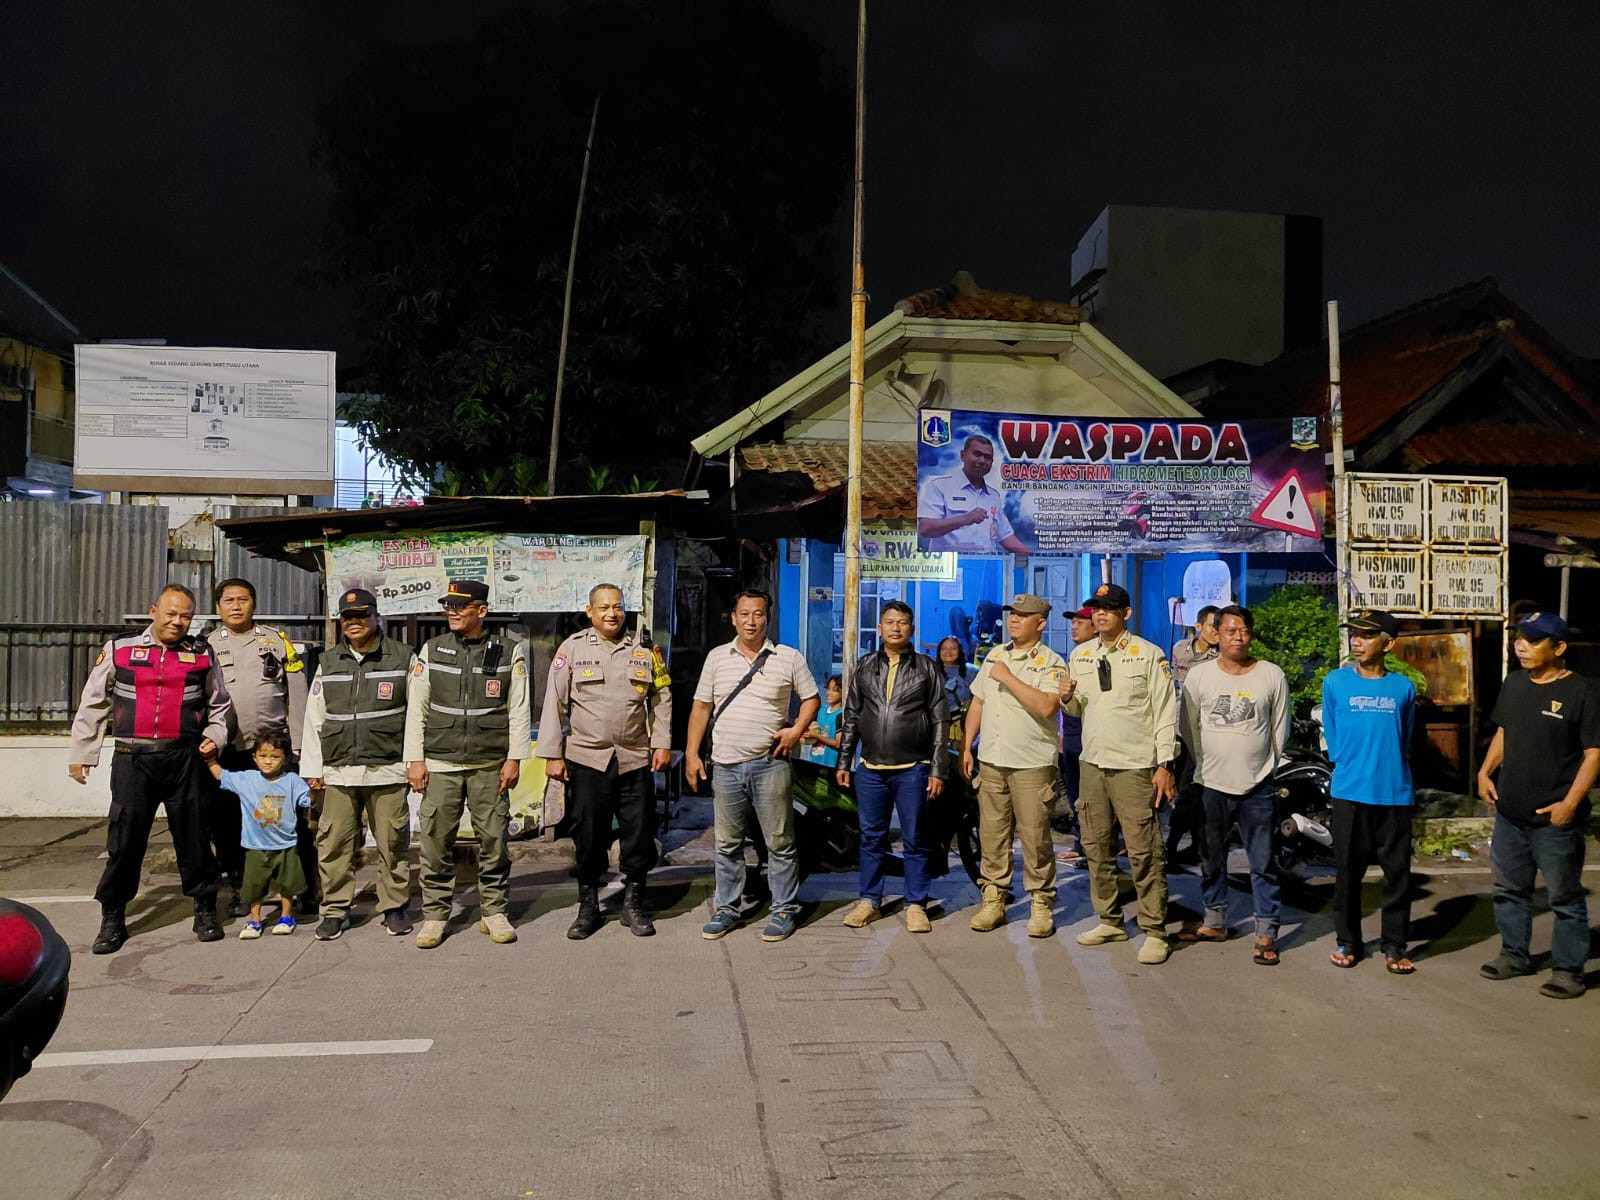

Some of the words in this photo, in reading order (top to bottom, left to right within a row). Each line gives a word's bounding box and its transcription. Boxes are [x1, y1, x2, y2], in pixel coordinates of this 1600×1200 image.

[1000, 420, 1251, 463] WASPADA
[1001, 463, 1048, 481] CUACA
[1051, 464, 1112, 481] EKSTRIM
[1115, 465, 1252, 482] HIDROMETEOROLOGI
[1001, 482, 1030, 490] BANJIR
[1361, 487, 1414, 504] EKRETARIAT
[1390, 505, 1404, 520] 05
[1472, 508, 1486, 523] 05
[1372, 523, 1390, 537] TUGU
[1394, 524, 1417, 537] UTARA
[1452, 525, 1470, 539] TUGU
[1473, 525, 1496, 540] UTARA
[383, 540, 400, 552] ES
[404, 538, 431, 551] TEH
[884, 541, 917, 559] RW.
[378, 552, 437, 571] JUMBO
[902, 565, 920, 573] TUGU
[921, 565, 944, 573] UTARA
[1358, 555, 1416, 574] POSYANDU
[1369, 574, 1389, 589] RW.
[1391, 574, 1405, 589] 05
[1470, 578, 1484, 593] 05
[382, 588, 399, 599] Rp
[400, 581, 432, 595] 3000
[1370, 592, 1388, 606] TUGU
[1452, 594, 1470, 608] TUGU
[1472, 595, 1495, 609] UTARA
